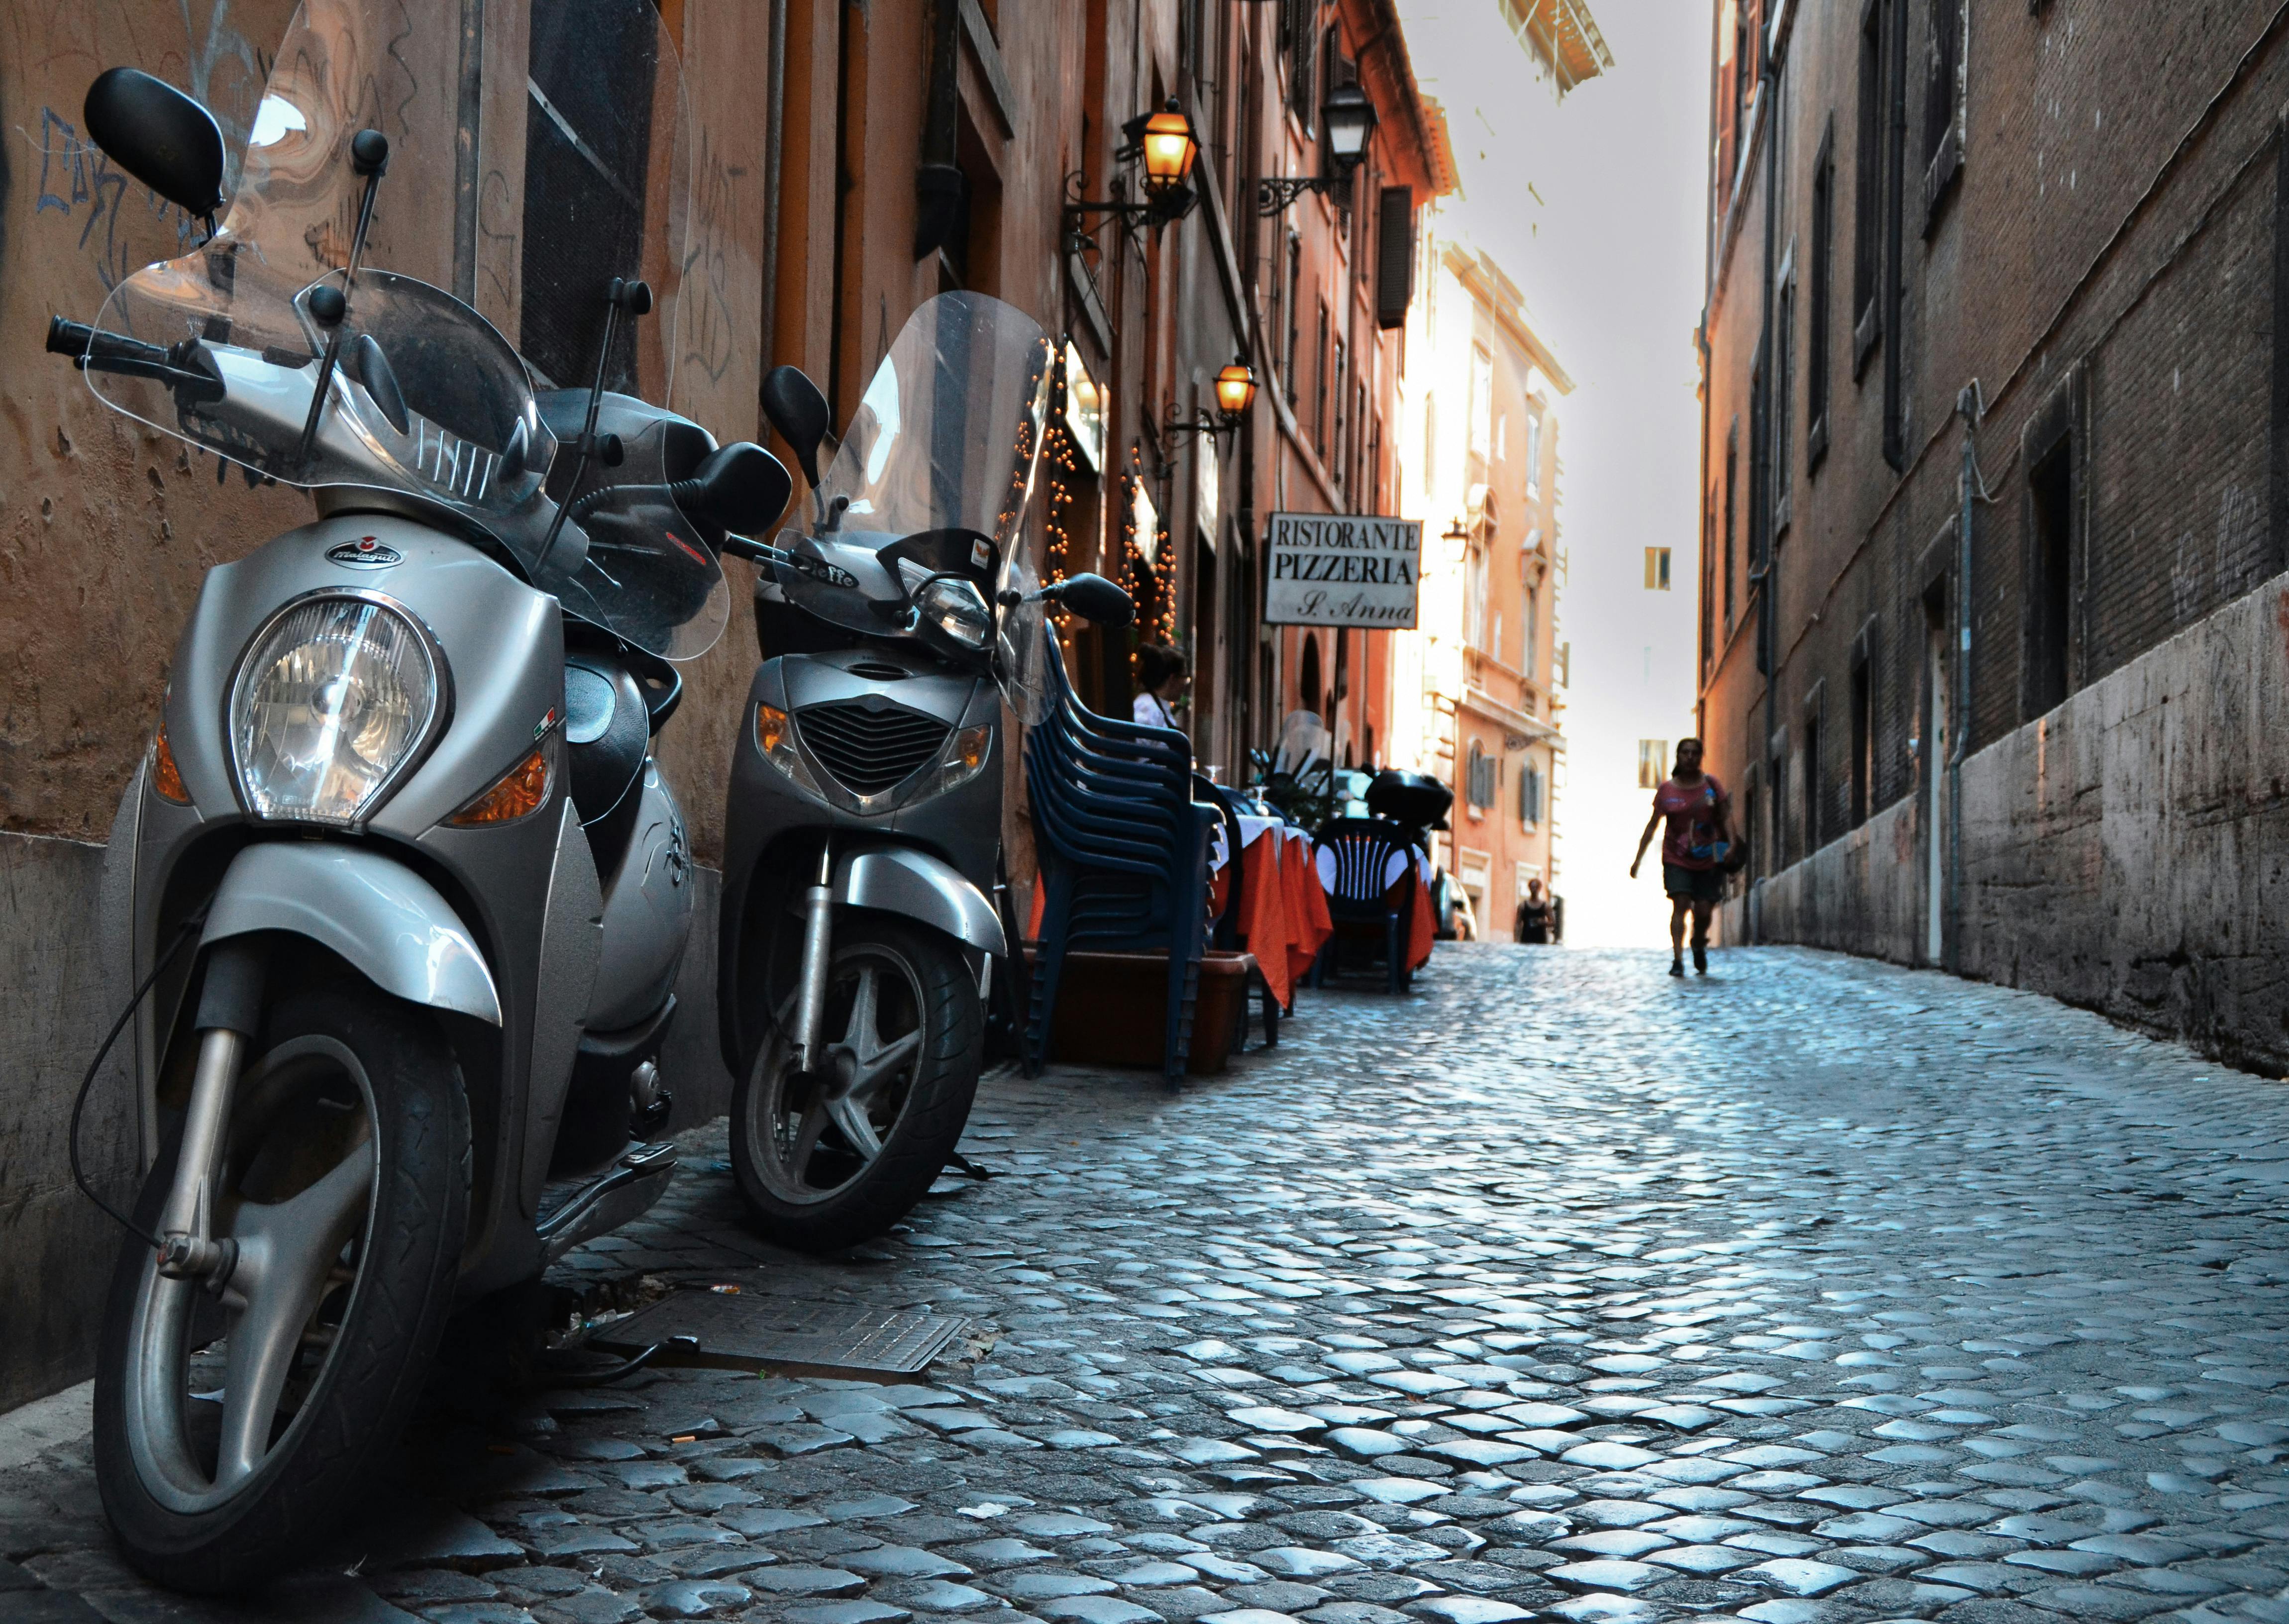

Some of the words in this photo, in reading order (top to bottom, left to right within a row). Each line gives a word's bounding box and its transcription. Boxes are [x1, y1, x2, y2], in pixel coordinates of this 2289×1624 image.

[1276, 519, 1418, 550] RISTORANTE
[1274, 553, 1413, 585] PIZZERIA
[1329, 592, 1413, 620] Anna
